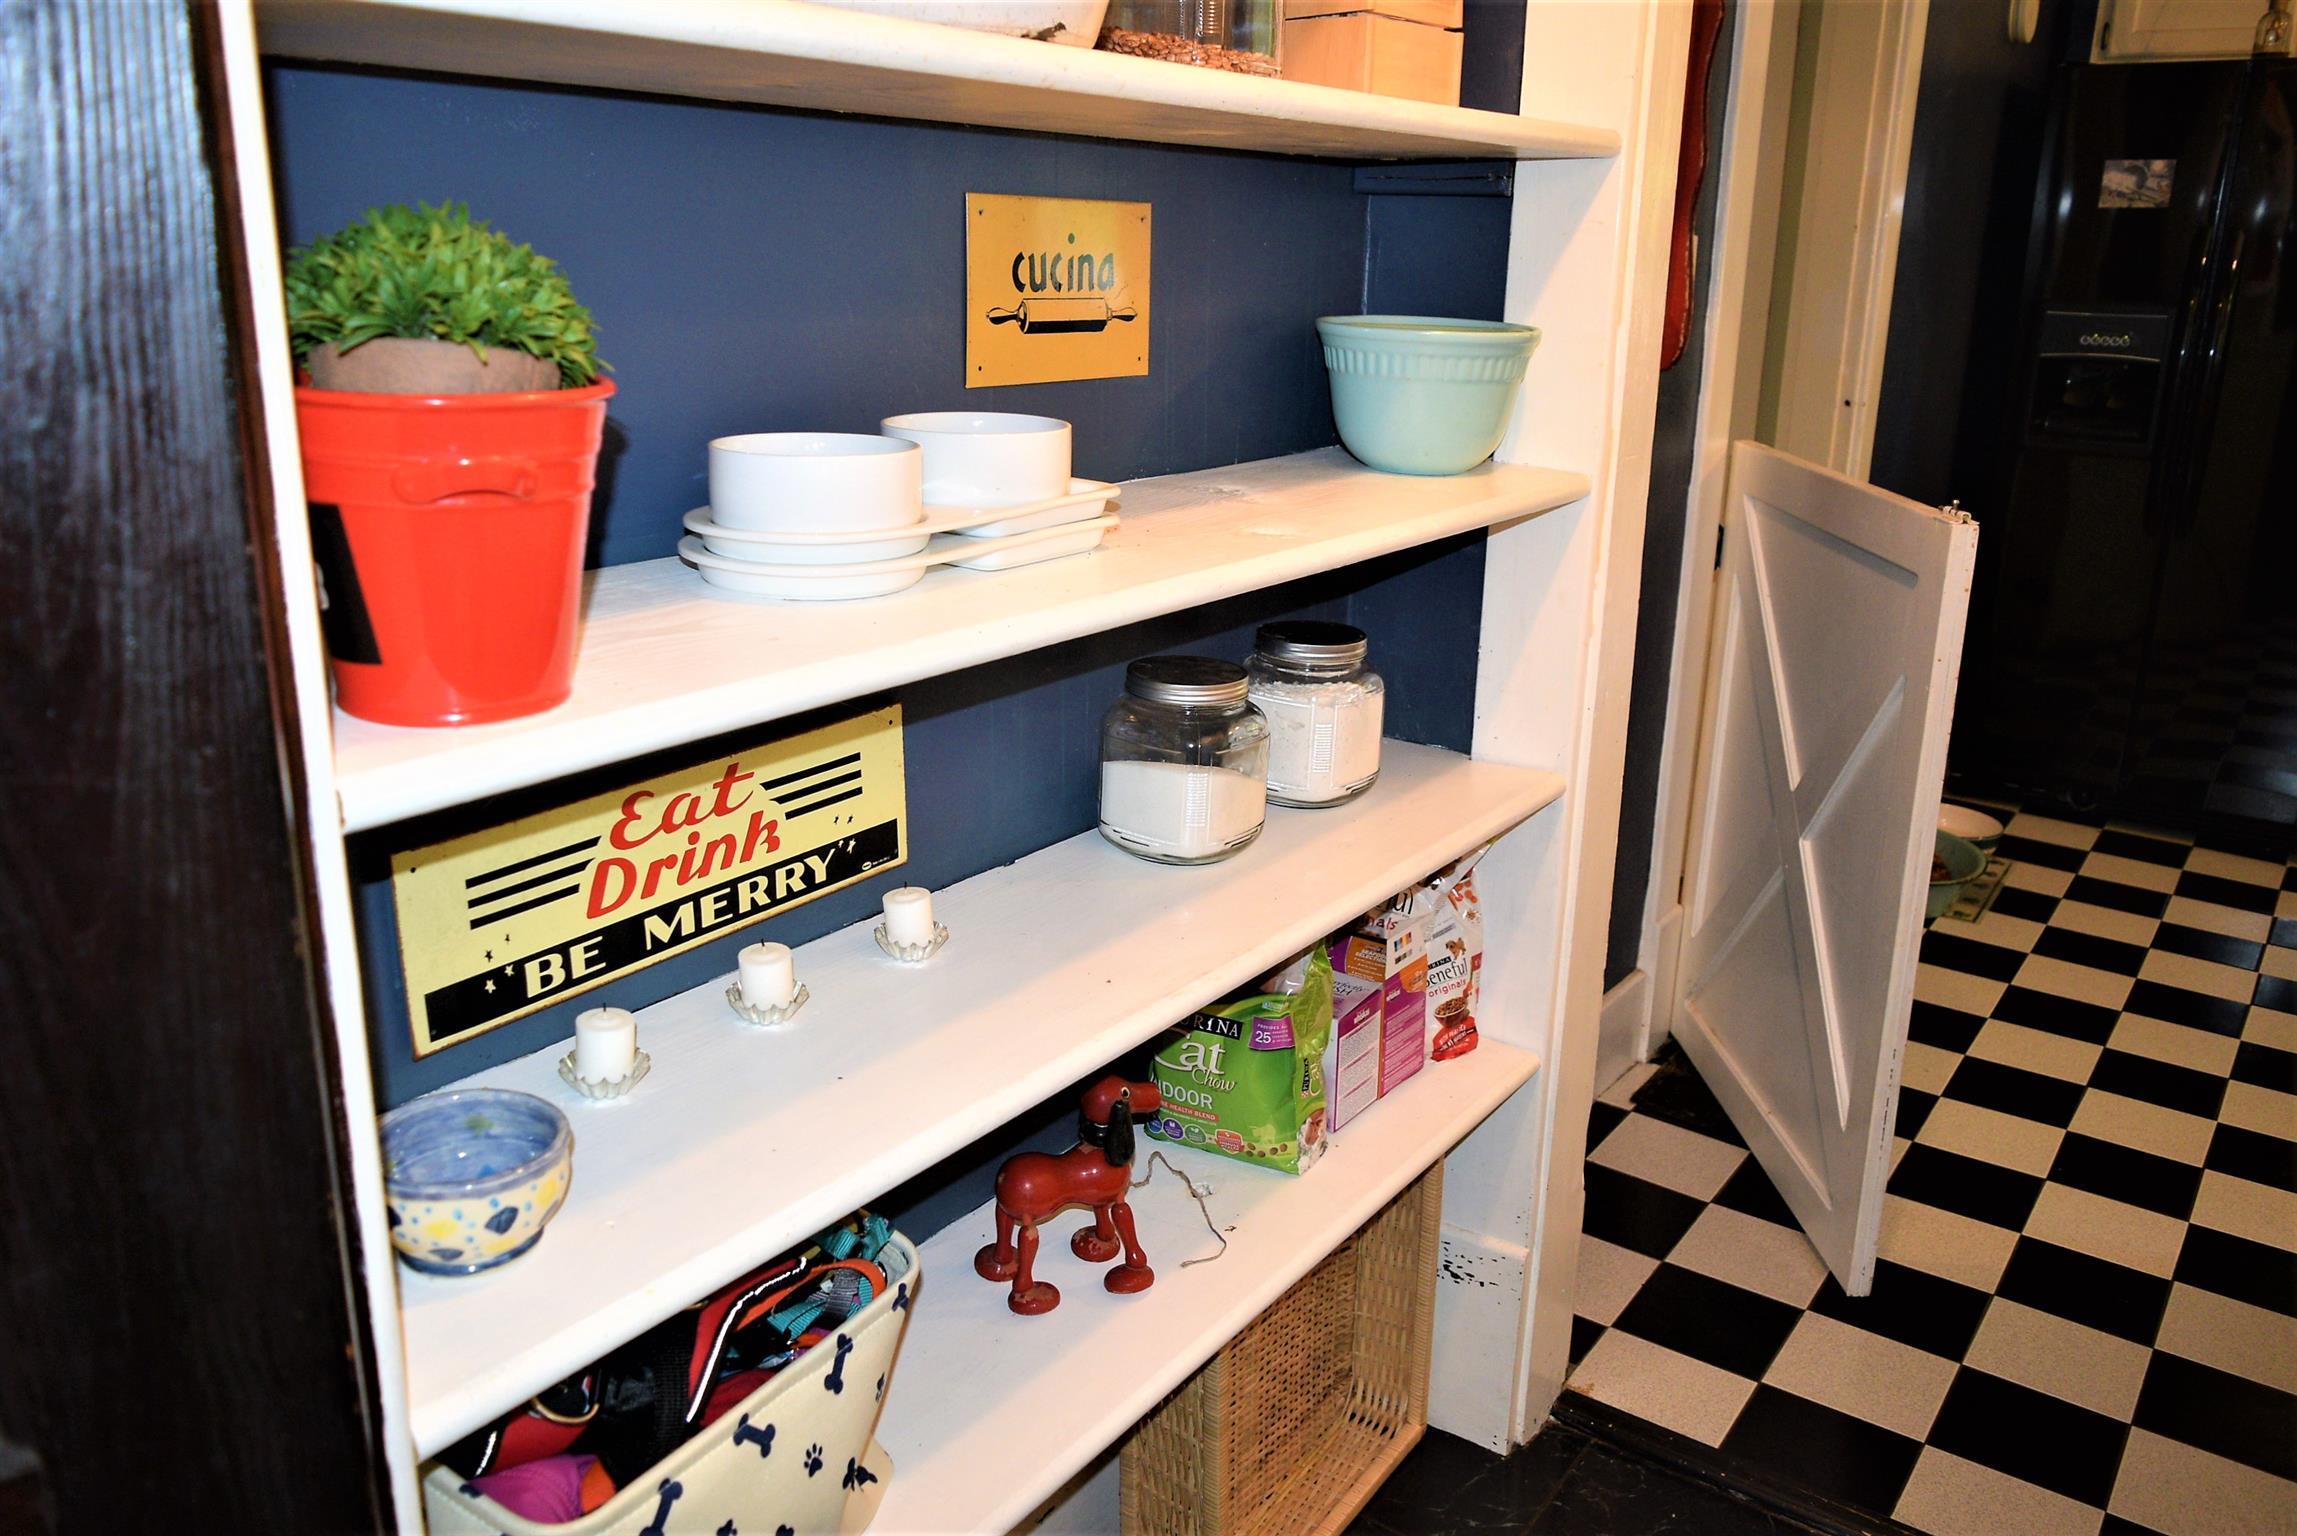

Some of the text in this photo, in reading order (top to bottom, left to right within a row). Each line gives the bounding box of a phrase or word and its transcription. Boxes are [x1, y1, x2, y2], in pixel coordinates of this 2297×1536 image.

[1012, 233, 1115, 293] cucina
[610, 763, 755, 851] Eat
[586, 811, 781, 919] Drink
[524, 848, 836, 998] BE MERRY
[1429, 958, 1450, 968] RINA
[1428, 979, 1466, 998] originals
[1180, 1013, 1239, 1038] URINA
[1255, 1030, 1272, 1043] 25
[1192, 1066, 1237, 1091] Chow
